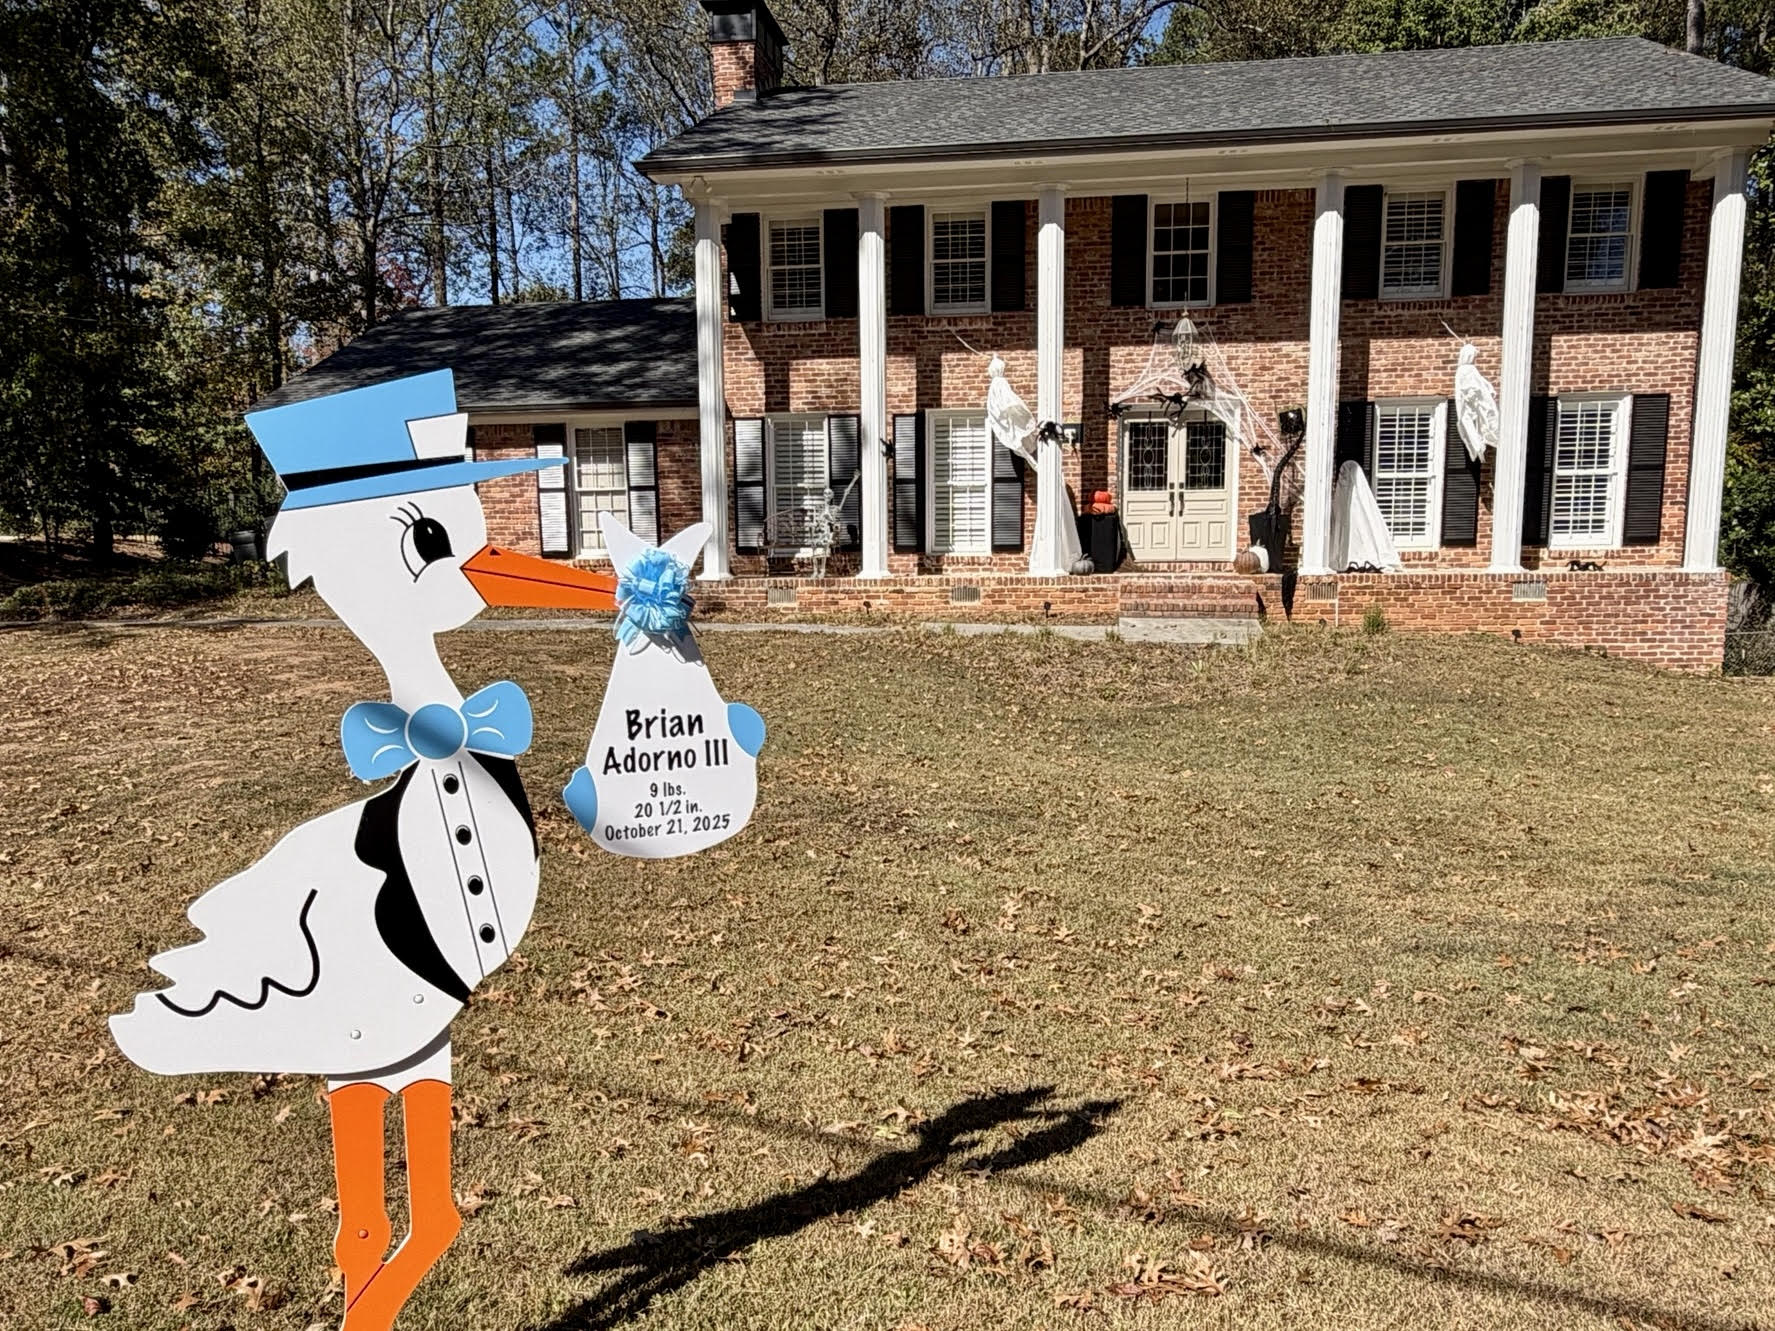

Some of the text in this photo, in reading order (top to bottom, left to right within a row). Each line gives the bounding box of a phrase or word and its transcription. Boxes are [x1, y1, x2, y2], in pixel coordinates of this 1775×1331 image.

[625, 708, 704, 741] Brian
[602, 738, 729, 776] Adorno III
[649, 781, 686, 798] 9 lbs.
[634, 799, 703, 819] 20 1/2 in.
[604, 813, 731, 842] October 21, 2025
